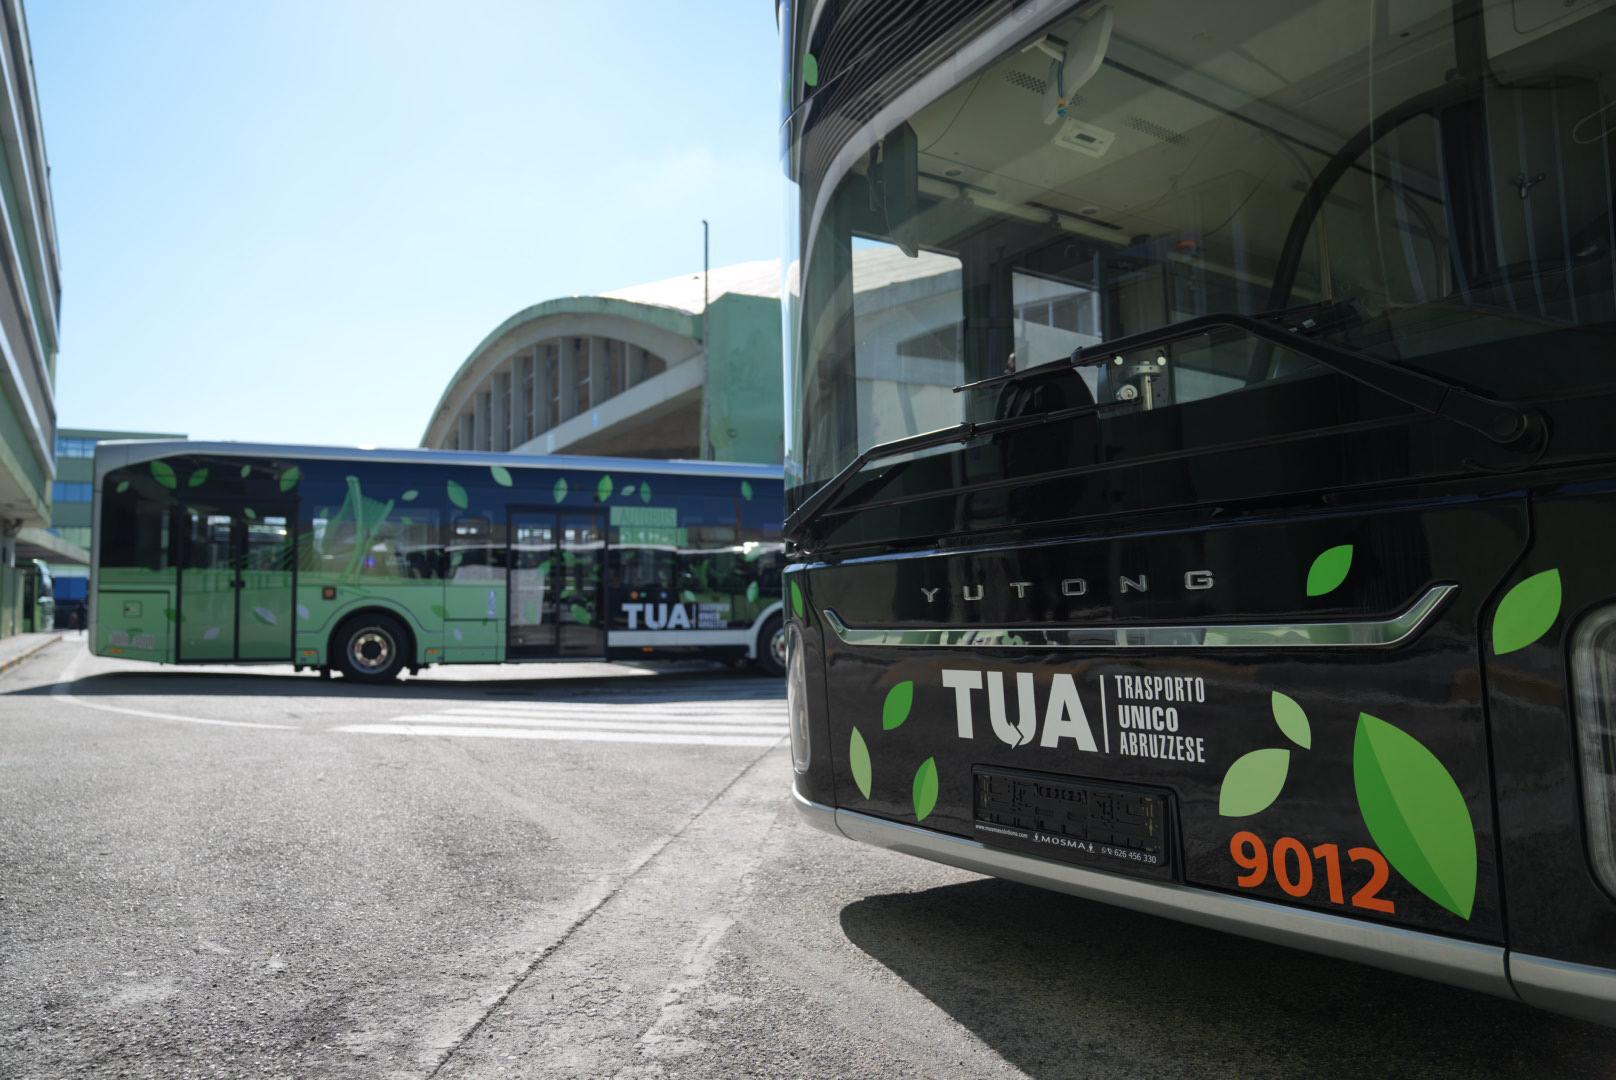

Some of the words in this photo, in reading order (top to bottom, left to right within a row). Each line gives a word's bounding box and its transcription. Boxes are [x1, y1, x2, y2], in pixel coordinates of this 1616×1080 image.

[920, 570, 1215, 603] YUTONG
[622, 603, 691, 629] TUA
[1114, 674, 1205, 703] TRASPORTO
[942, 669, 1099, 752] TUA
[1118, 704, 1179, 732] UNICO
[1120, 731, 1206, 763] ABRUZZESE
[1041, 835, 1087, 851] MOSMA
[1114, 849, 1127, 858] 626
[1128, 852, 1142, 861] 456
[1143, 854, 1157, 864] 330
[1230, 831, 1396, 914] 9012
